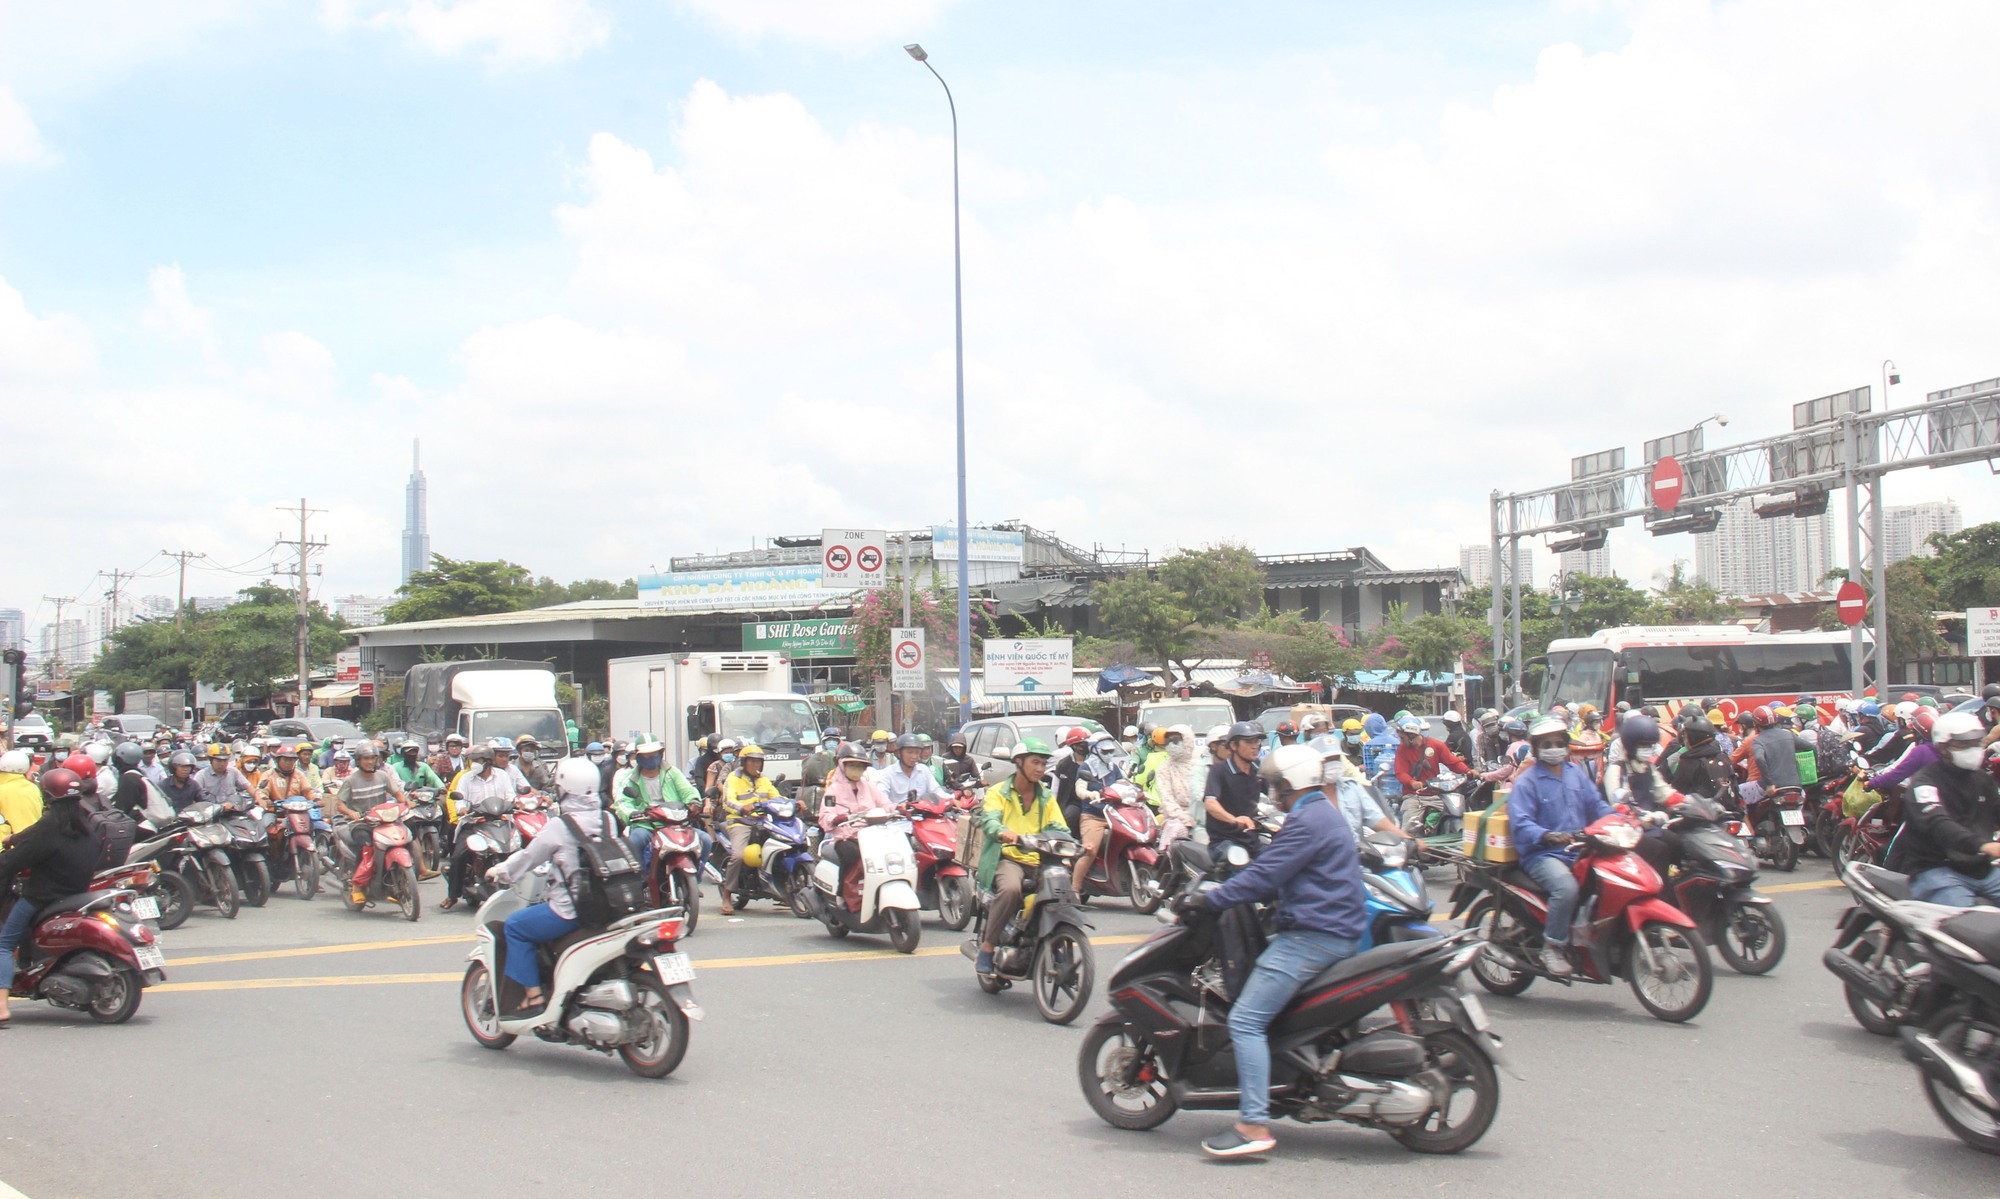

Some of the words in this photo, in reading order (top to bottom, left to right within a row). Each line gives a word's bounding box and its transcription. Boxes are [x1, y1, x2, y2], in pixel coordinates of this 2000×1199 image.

[844, 531, 865, 540] ZONE
[746, 570, 765, 578] TNHH
[661, 583, 701, 596] KHO
[707, 579, 734, 594] ĐÁ
[740, 577, 808, 592] HOÀNG
[768, 623, 791, 639] SHE
[792, 622, 818, 638] Rose
[900, 630, 917, 639] ZONE
[986, 653, 1005, 661] BỆNH
[1007, 653, 1023, 661] VIỆN
[1025, 651, 1047, 661] QUỐC
[1049, 650, 1057, 660] TẾ
[1059, 652, 1069, 660] MỸ
